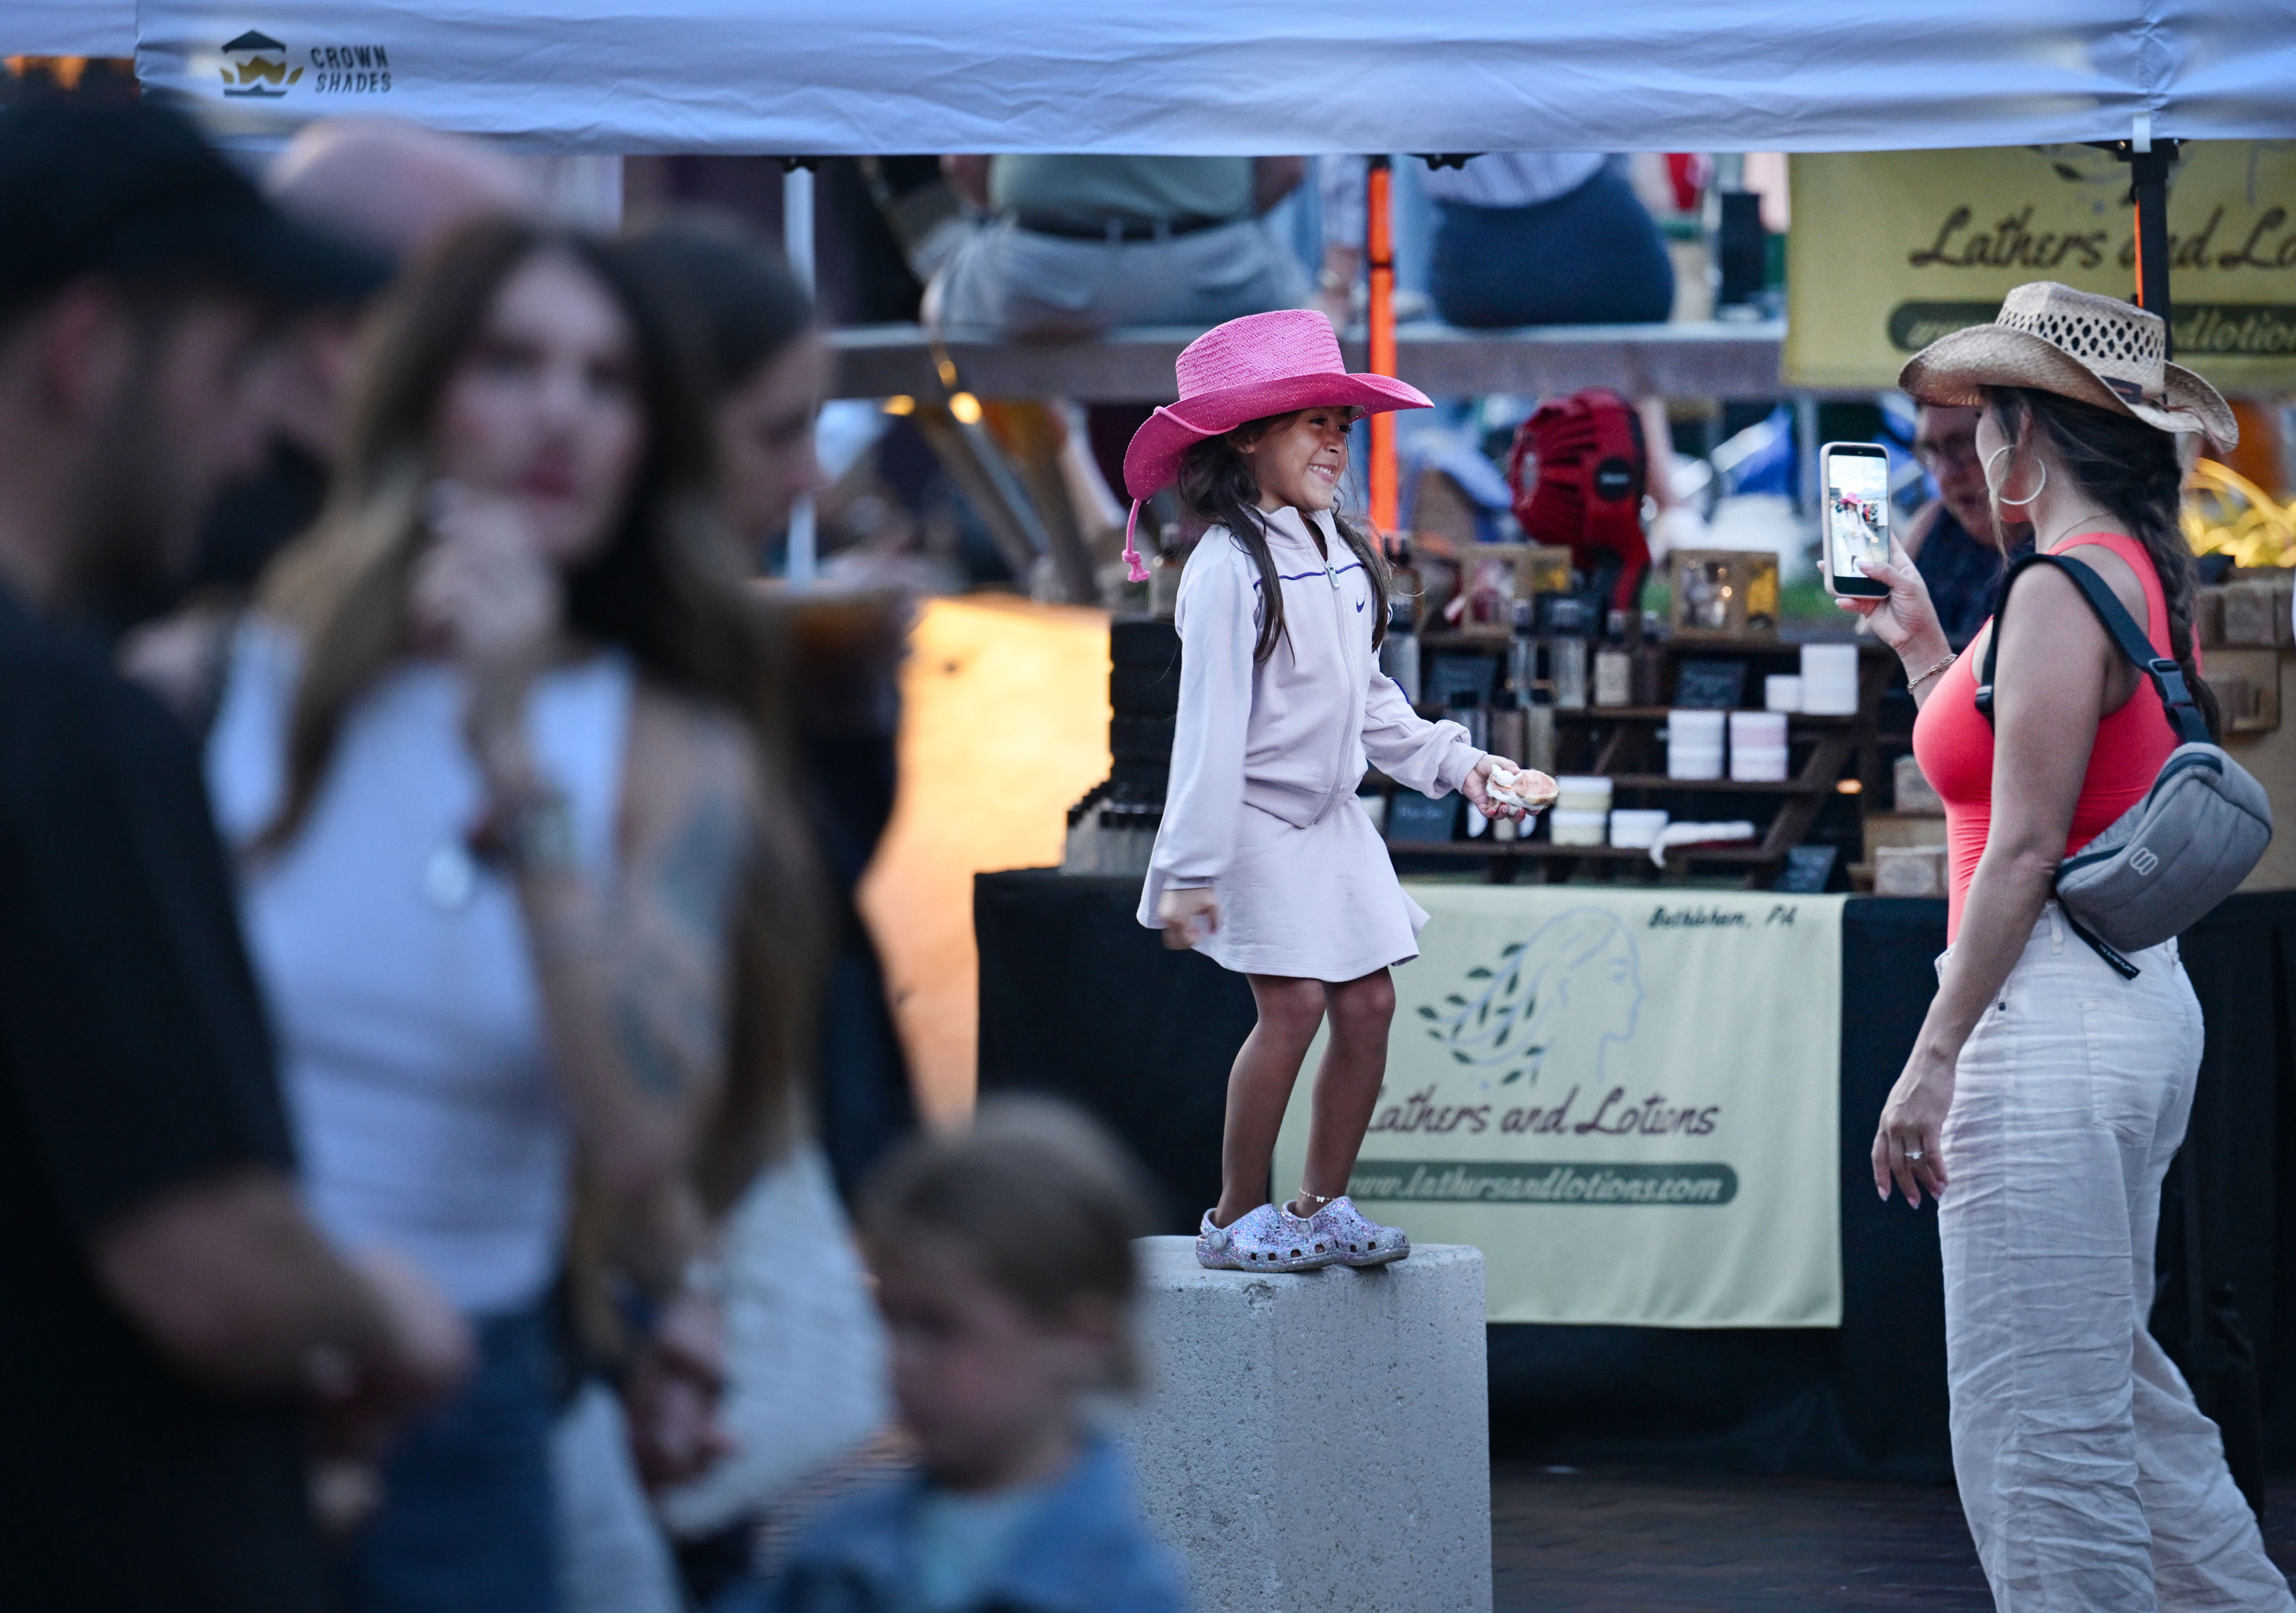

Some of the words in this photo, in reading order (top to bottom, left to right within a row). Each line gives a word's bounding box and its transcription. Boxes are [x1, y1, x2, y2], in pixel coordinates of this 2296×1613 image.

[310, 44, 388, 70] CROWN
[315, 71, 392, 94] SHADES
[1909, 205, 2107, 268] Lathers
[2118, 204, 2224, 269] ad
[1764, 904, 1798, 927] PA
[1499, 1083, 1580, 1134] and
